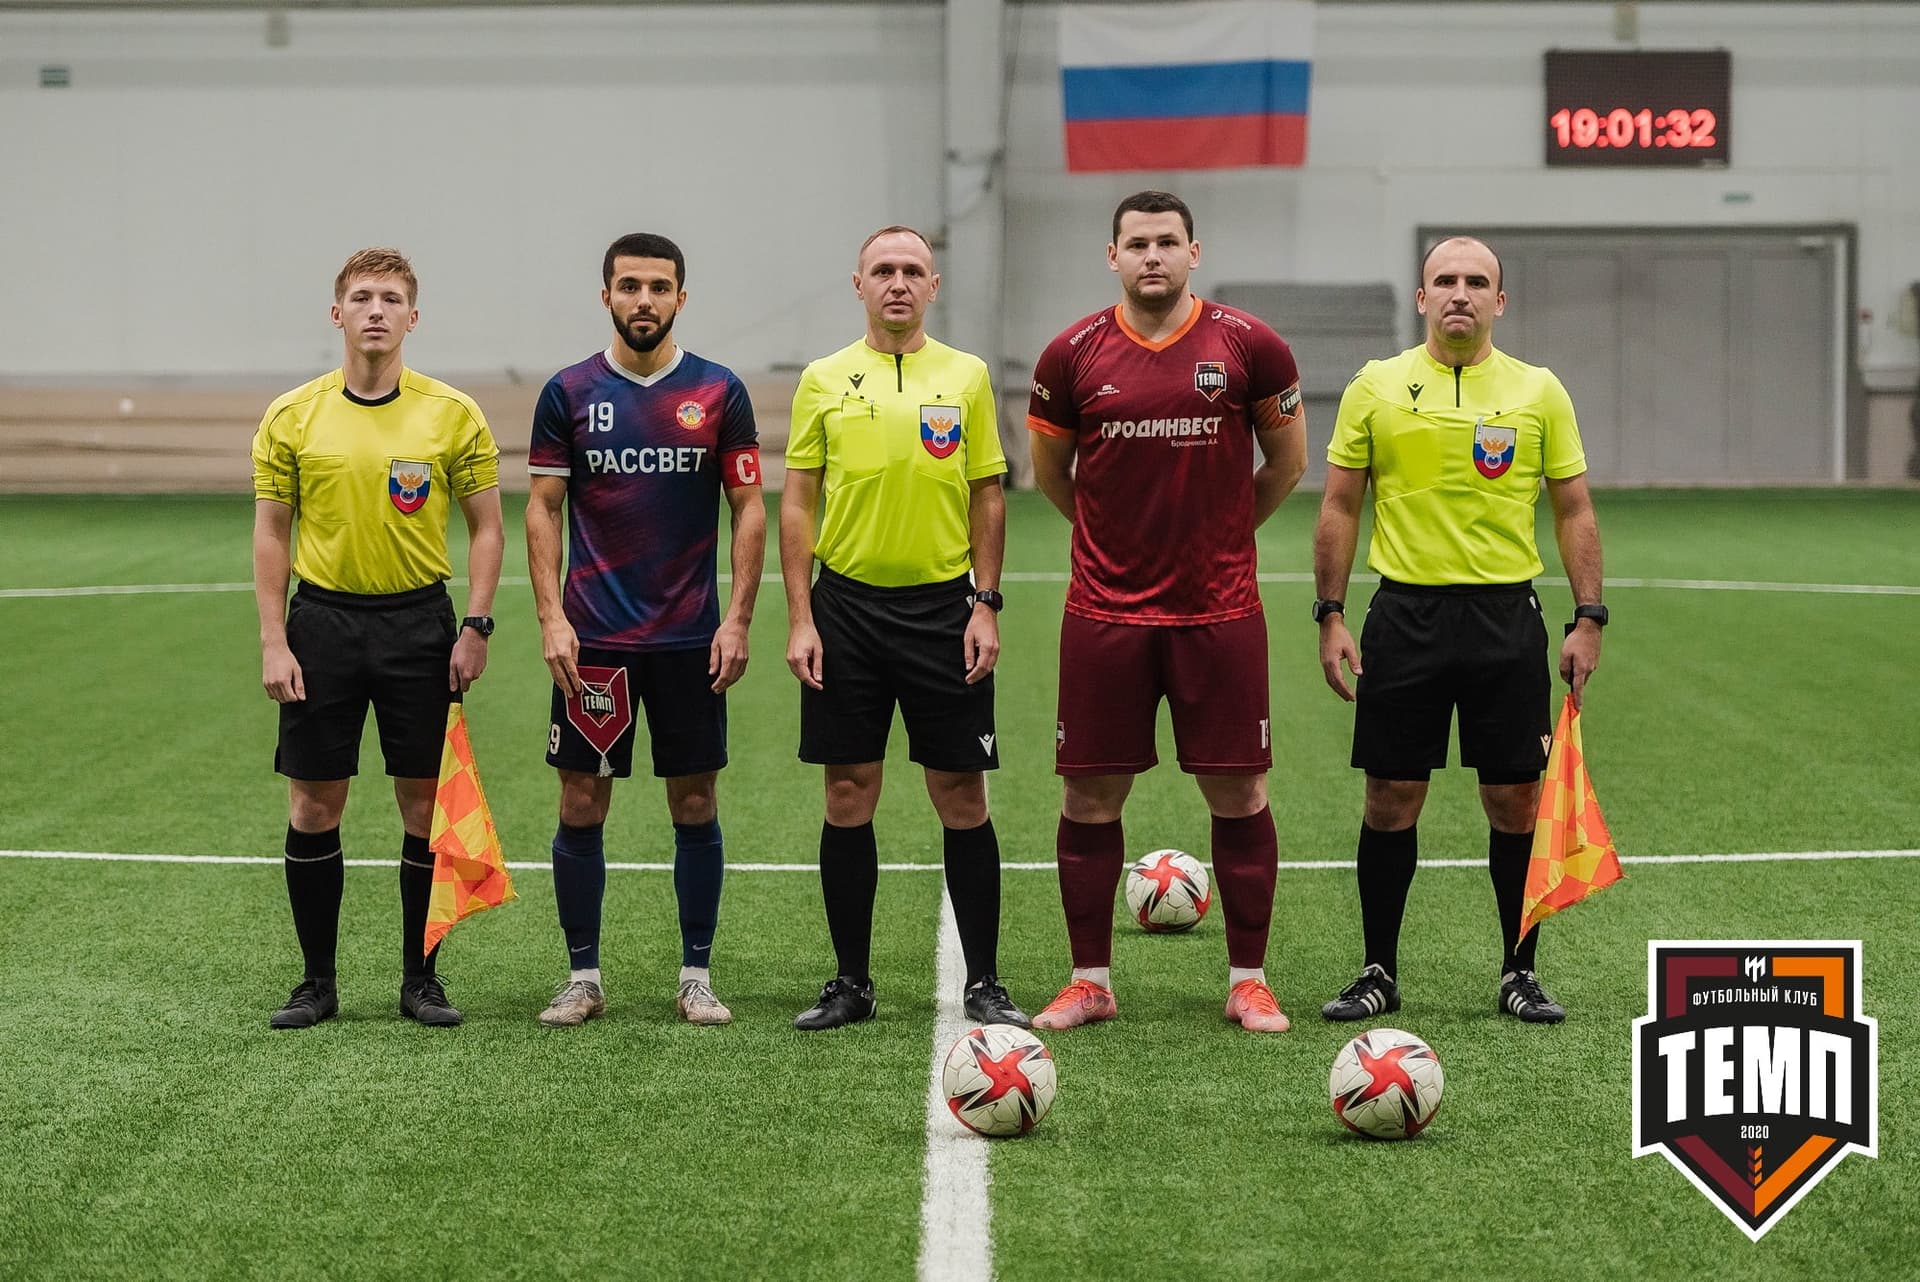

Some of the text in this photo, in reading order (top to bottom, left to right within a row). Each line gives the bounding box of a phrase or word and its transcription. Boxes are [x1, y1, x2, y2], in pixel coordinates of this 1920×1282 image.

[1551, 108, 1716, 148] 19:01:32
[1198, 373, 1224, 387] ТЕМП
[588, 402, 614, 432] 19
[1101, 417, 1222, 439] ПРОДИНВЕСТ
[585, 448, 707, 474] РАССВЕТ
[584, 696, 612, 712] ТЕМП
[1259, 718, 1269, 749] 1
